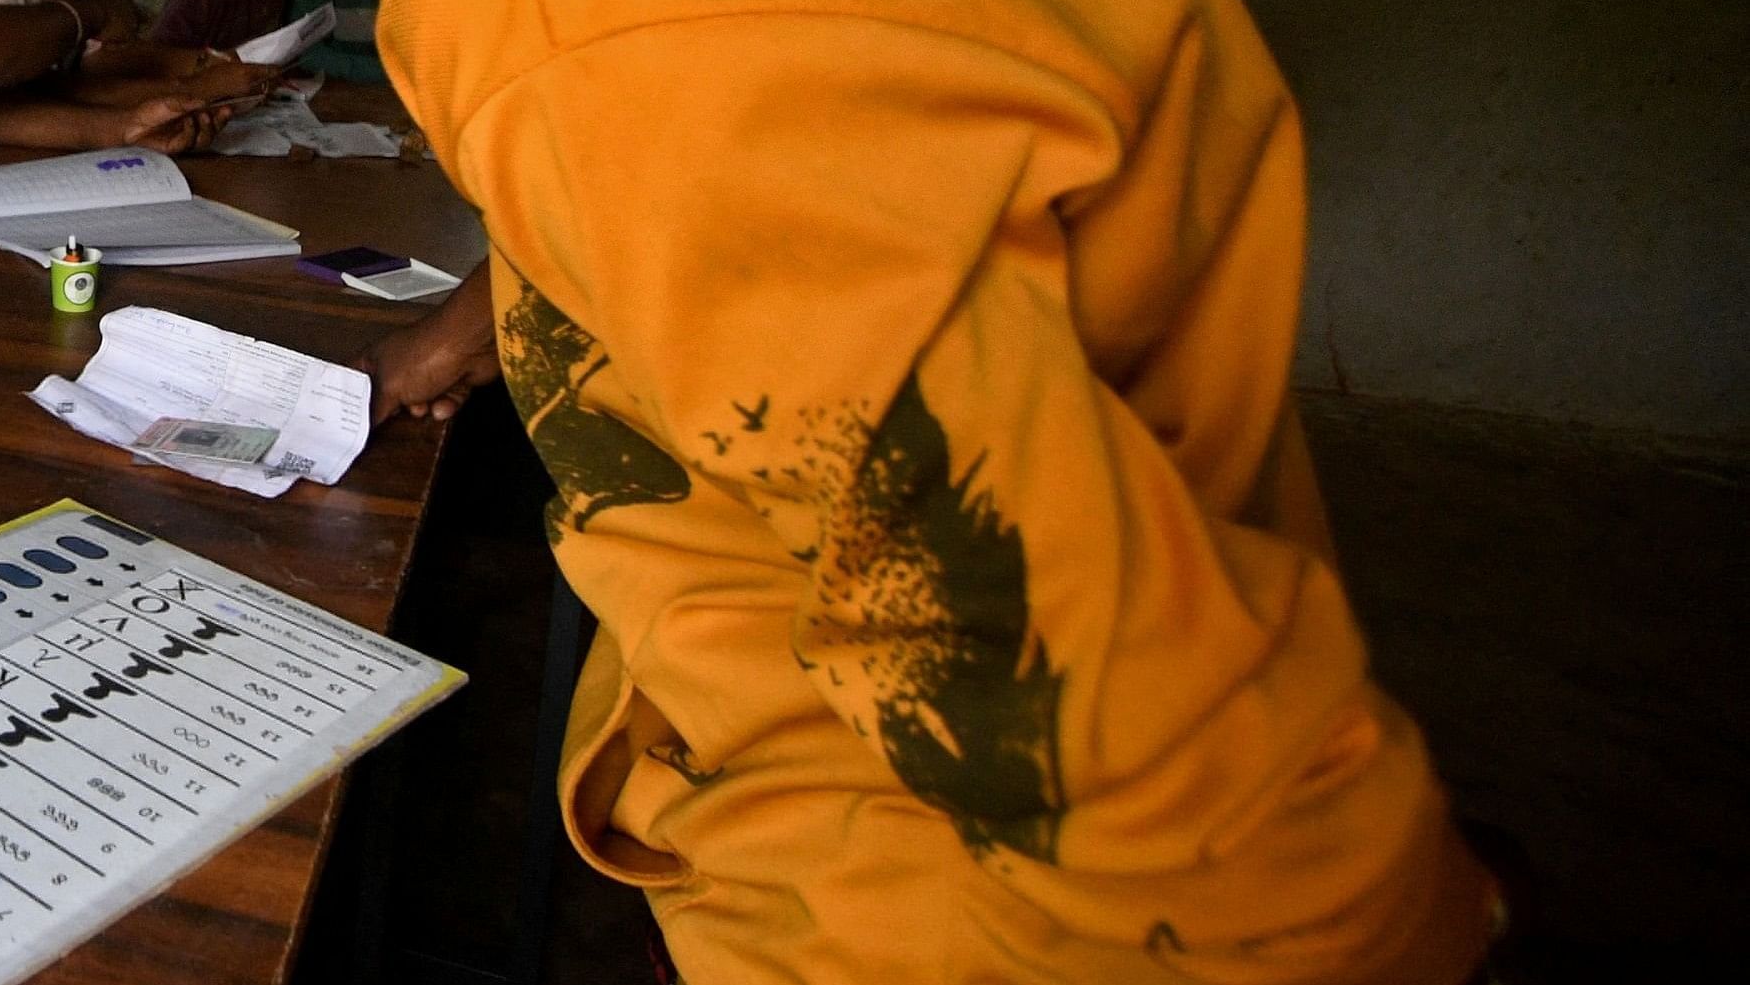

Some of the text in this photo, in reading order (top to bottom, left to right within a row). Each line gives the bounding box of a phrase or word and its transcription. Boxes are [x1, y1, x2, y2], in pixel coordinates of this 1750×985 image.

[357, 664, 376, 676] 16
[327, 683, 346, 695] 15
[293, 705, 316, 717] 14
[224, 752, 246, 767] 12
[184, 779, 207, 794] 11
[138, 807, 164, 822] 10
[101, 842, 117, 853] 9
[51, 873, 68, 886] 8
